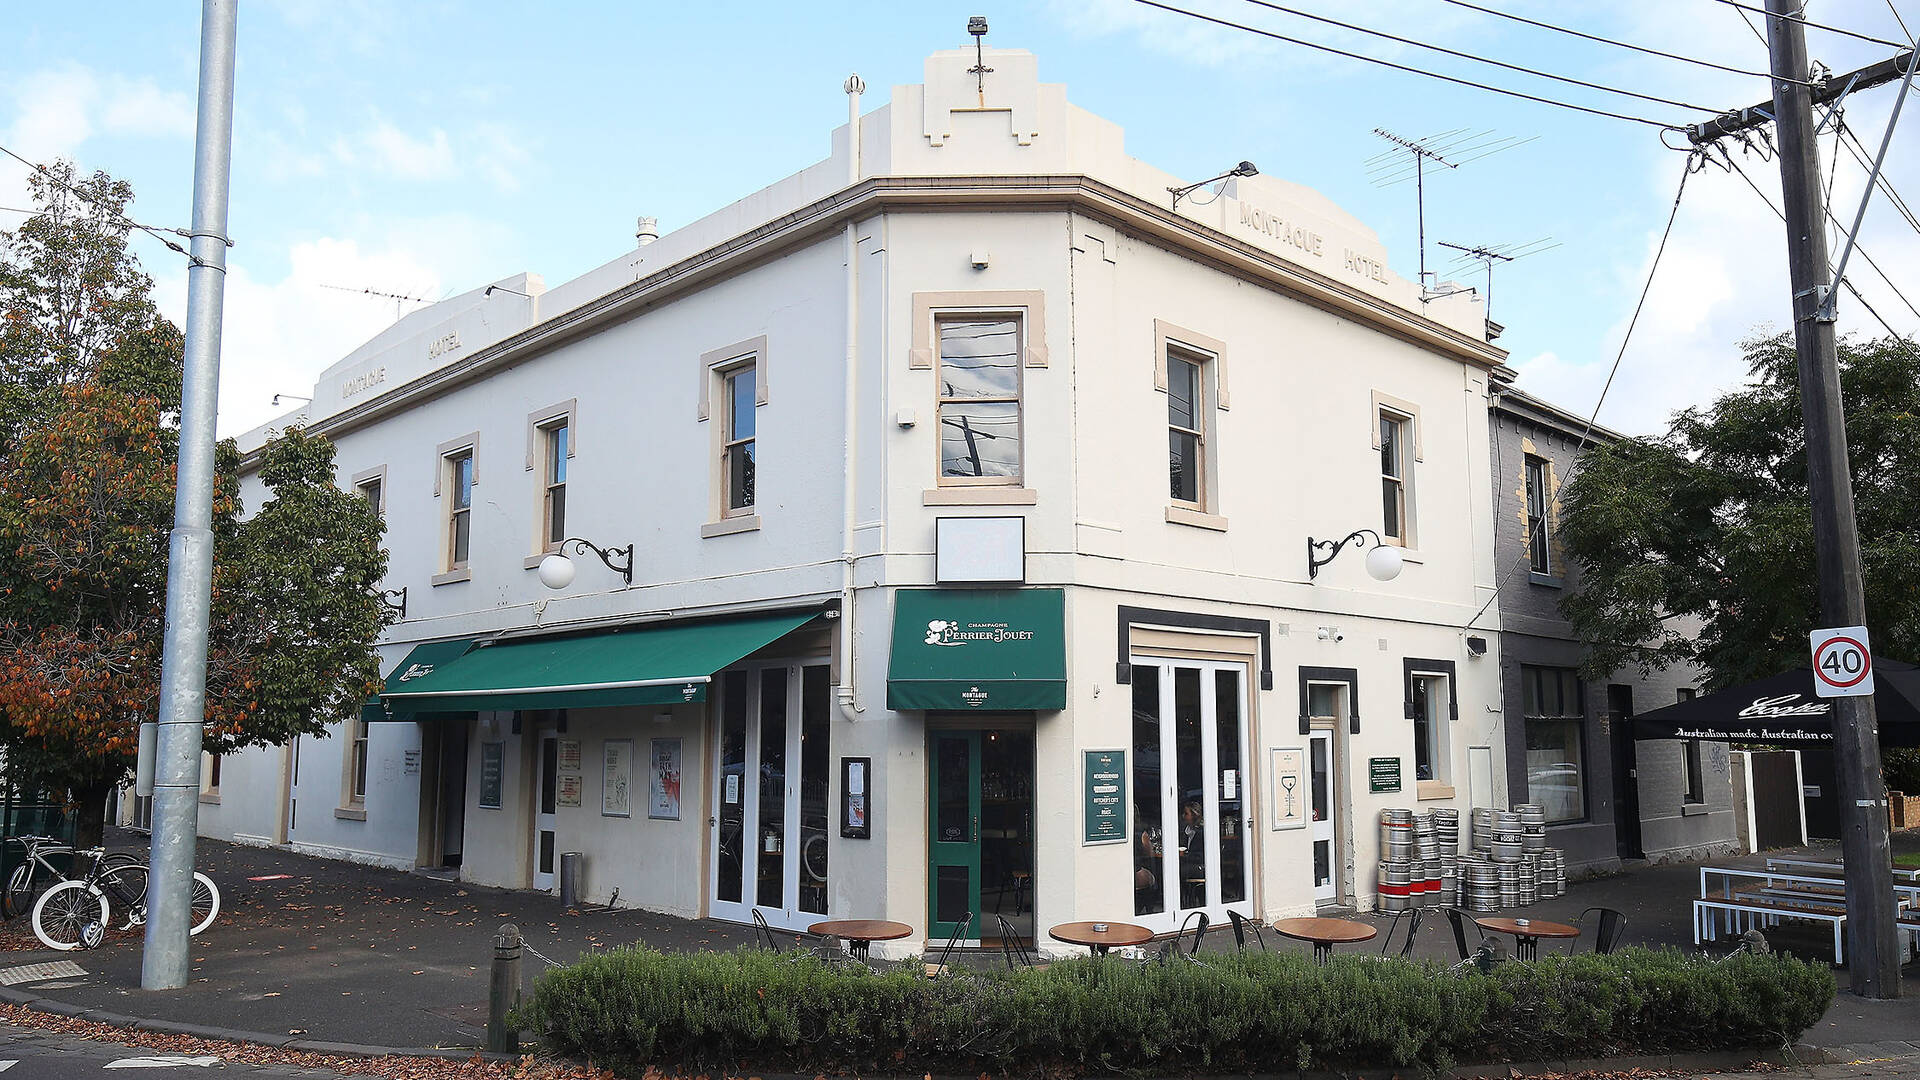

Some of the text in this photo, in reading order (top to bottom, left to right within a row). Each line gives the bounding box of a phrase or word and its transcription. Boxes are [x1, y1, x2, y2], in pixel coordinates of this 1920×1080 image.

[1344, 248, 1389, 285] HOTEL
[429, 330, 462, 360] HOTEL
[1822, 649, 1861, 674] 40
[1675, 727, 1729, 738] Australian
[1730, 728, 1760, 739] made.
[1761, 728, 1819, 740] Australian
